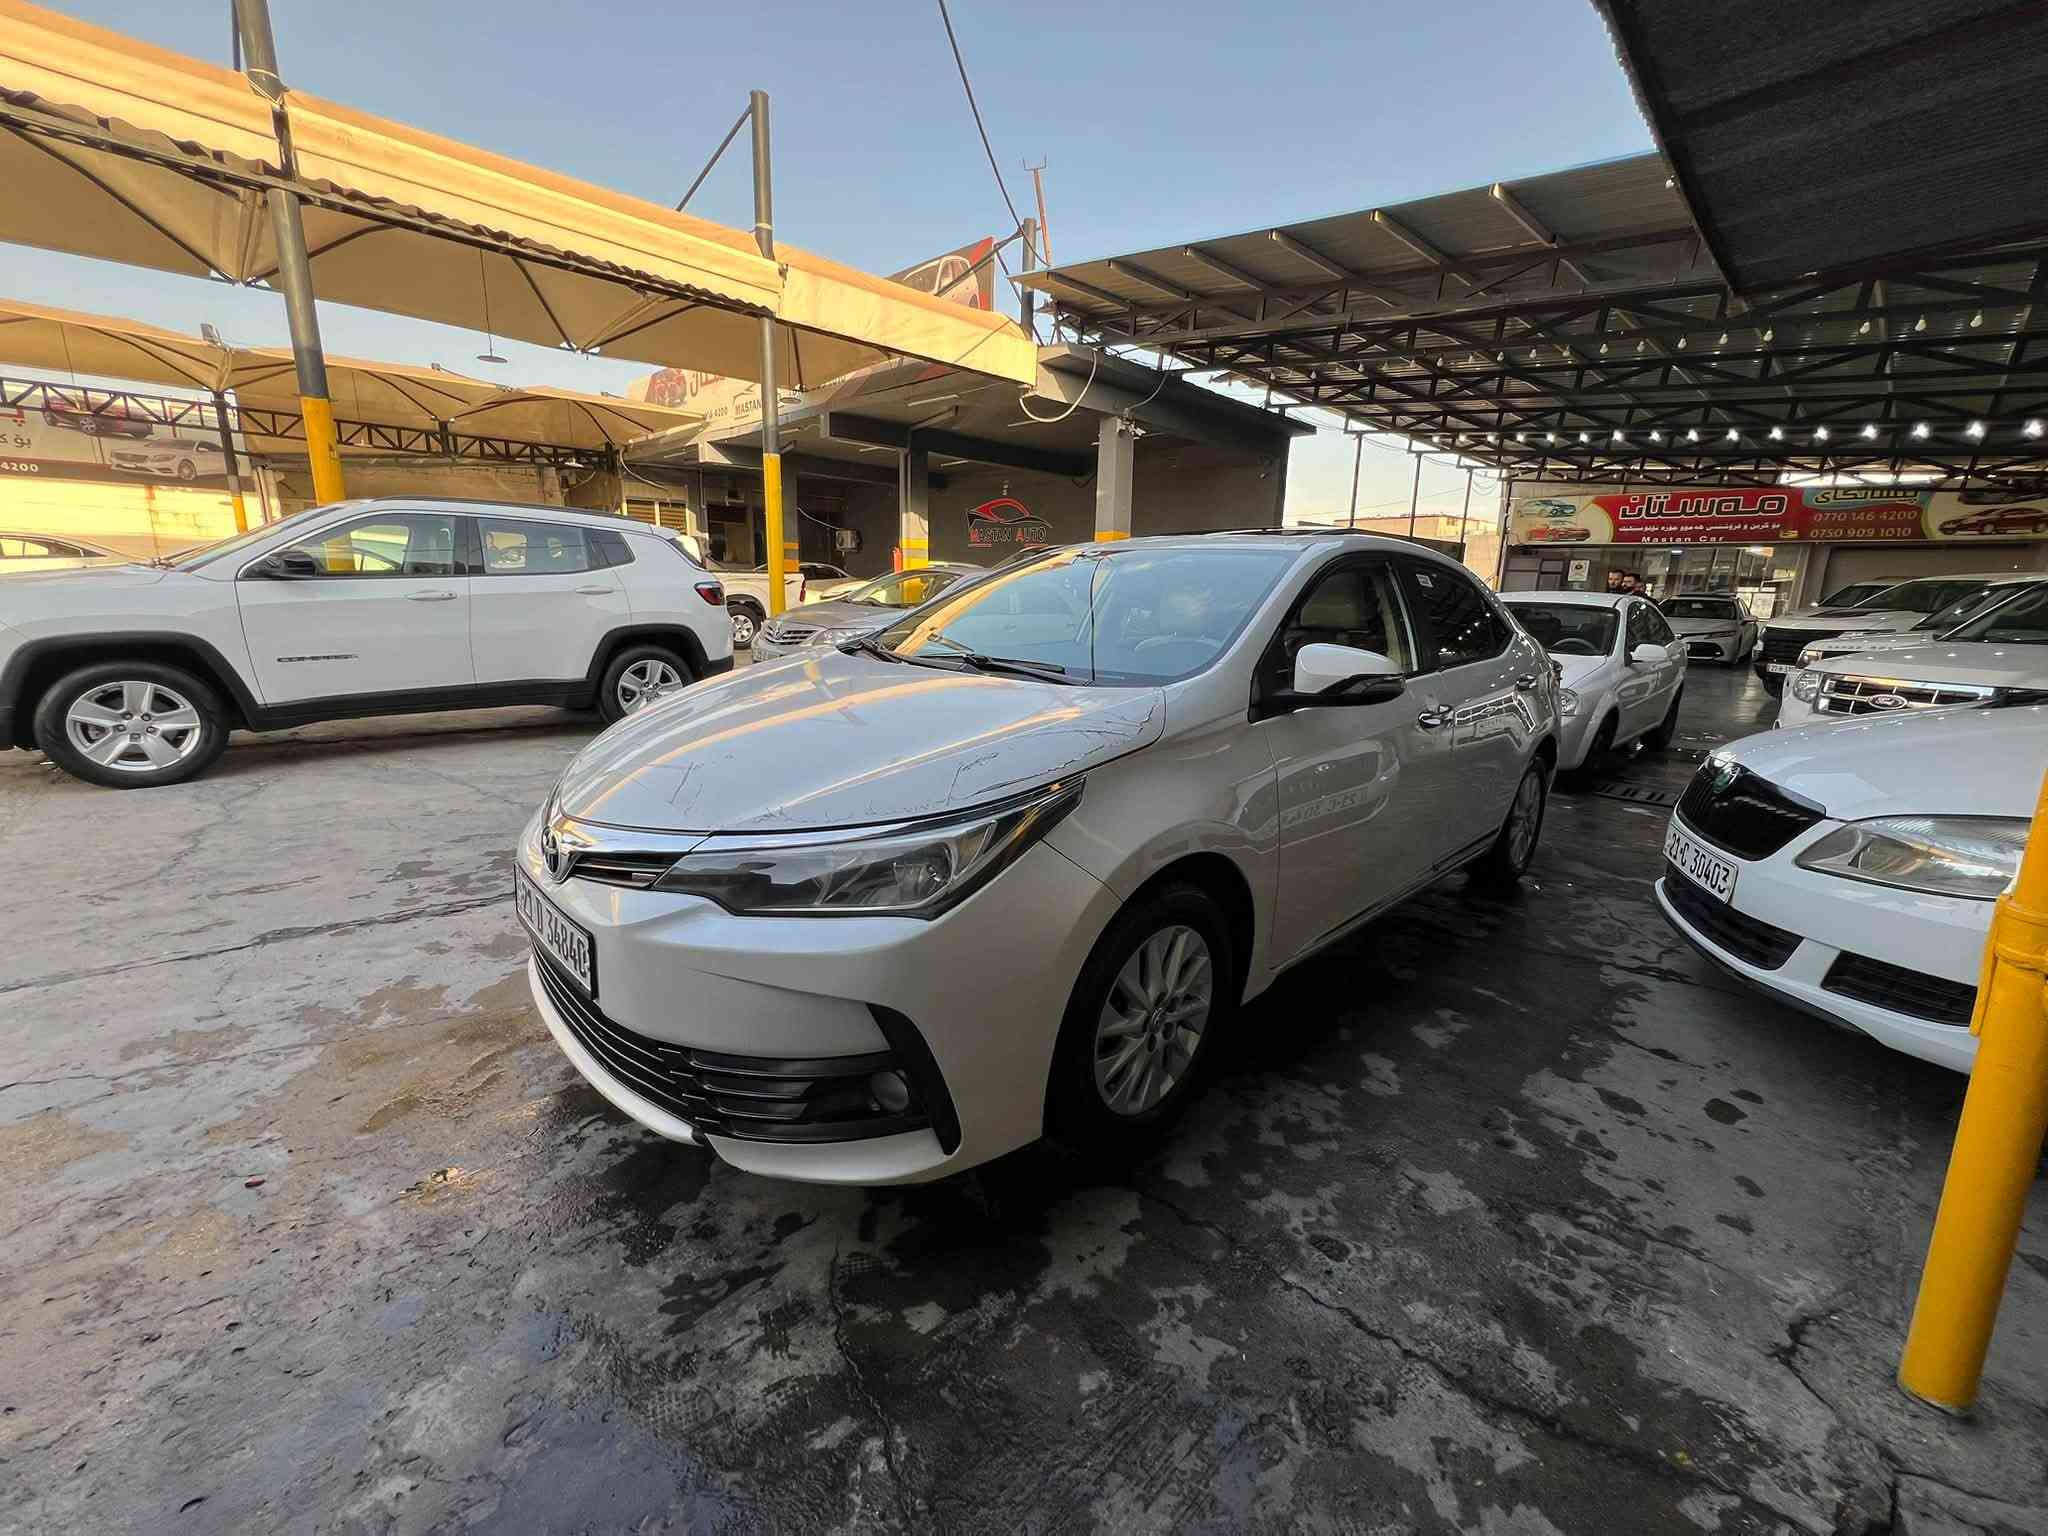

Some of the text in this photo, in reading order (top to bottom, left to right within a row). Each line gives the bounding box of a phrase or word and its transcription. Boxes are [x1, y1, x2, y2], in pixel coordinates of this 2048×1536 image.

[1618, 494, 1788, 520] مەستان
[1812, 510, 1919, 521] 0770 146 4200
[969, 527, 1047, 543] MASTAN AUTO
[1810, 527, 1912, 538] 0750 909 1010
[1690, 849, 1729, 894] 30403
